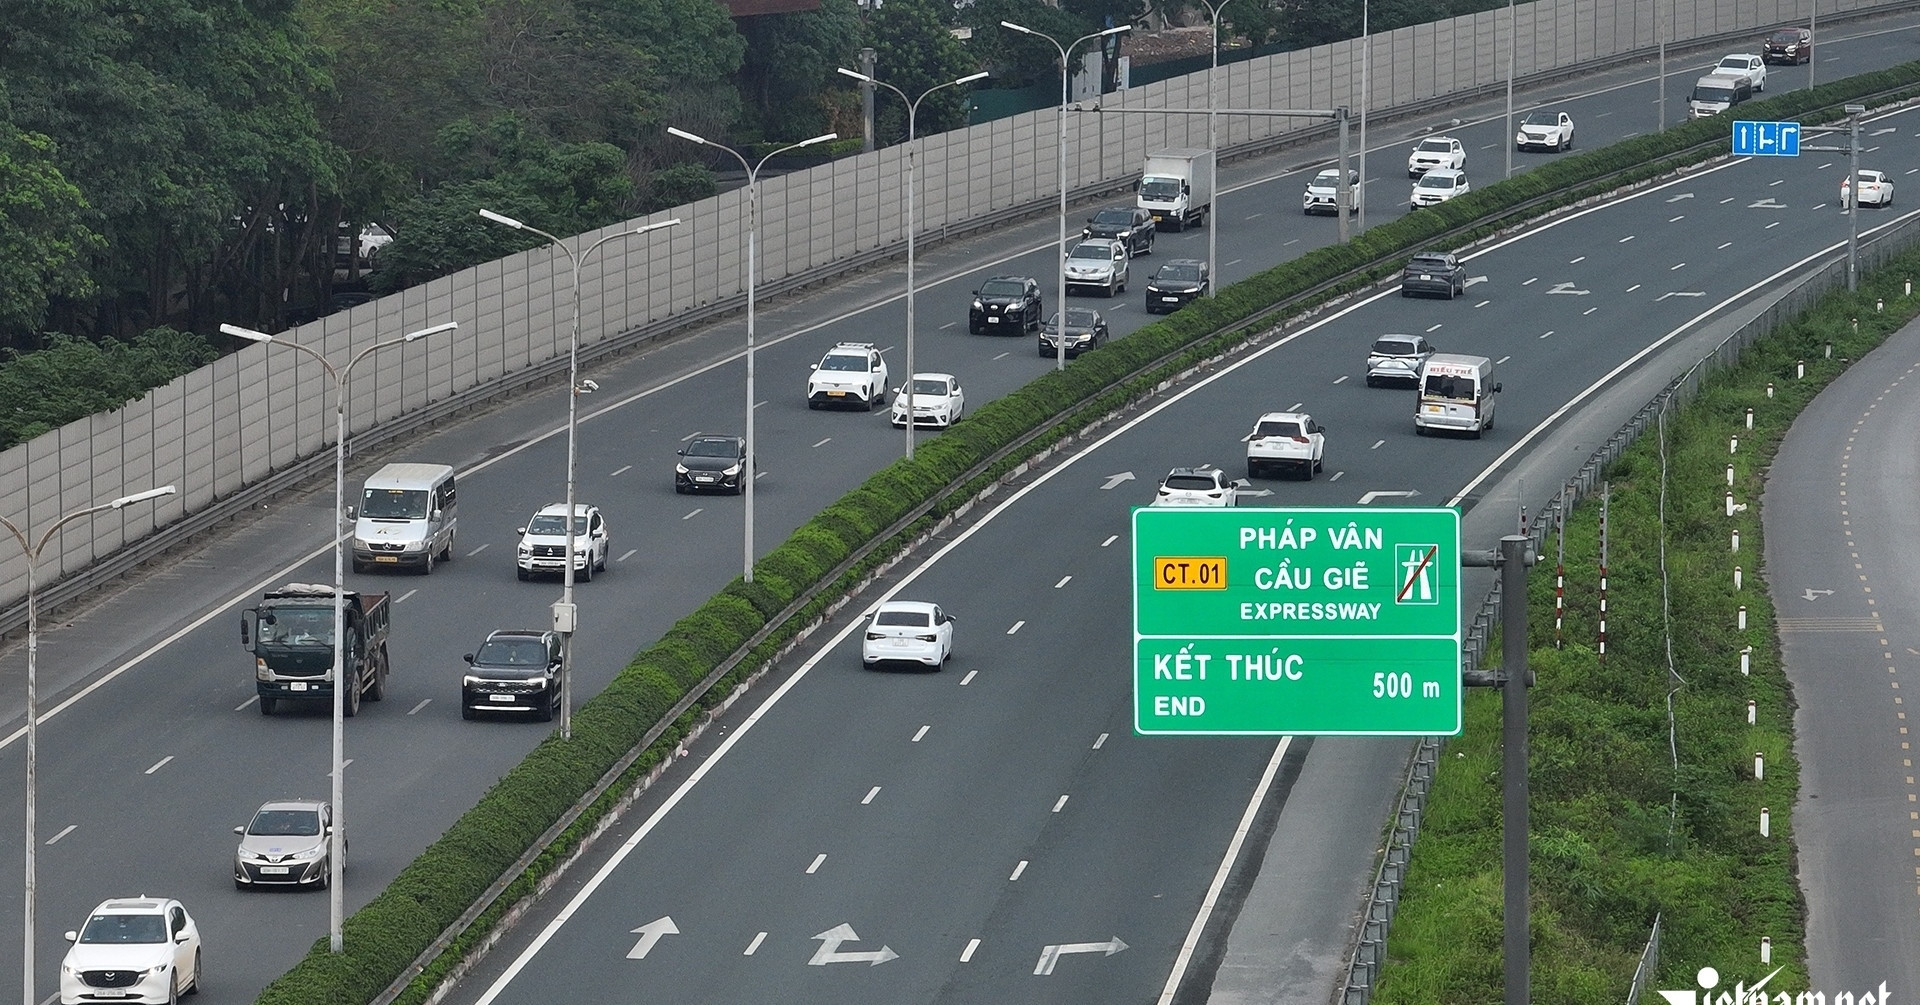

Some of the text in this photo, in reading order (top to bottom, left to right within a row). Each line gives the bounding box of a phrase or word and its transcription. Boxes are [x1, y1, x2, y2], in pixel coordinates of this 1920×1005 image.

[1239, 518, 1383, 550] PHÁP VÂN
[1162, 563, 1220, 585] CT.01
[1254, 557, 1369, 590] CẦU GIẼ
[1240, 602, 1382, 621] EXPRESSWAY
[1154, 643, 1304, 681] KẾT THÚC
[1372, 671, 1440, 699] 500 m
[1154, 695, 1206, 717] END
